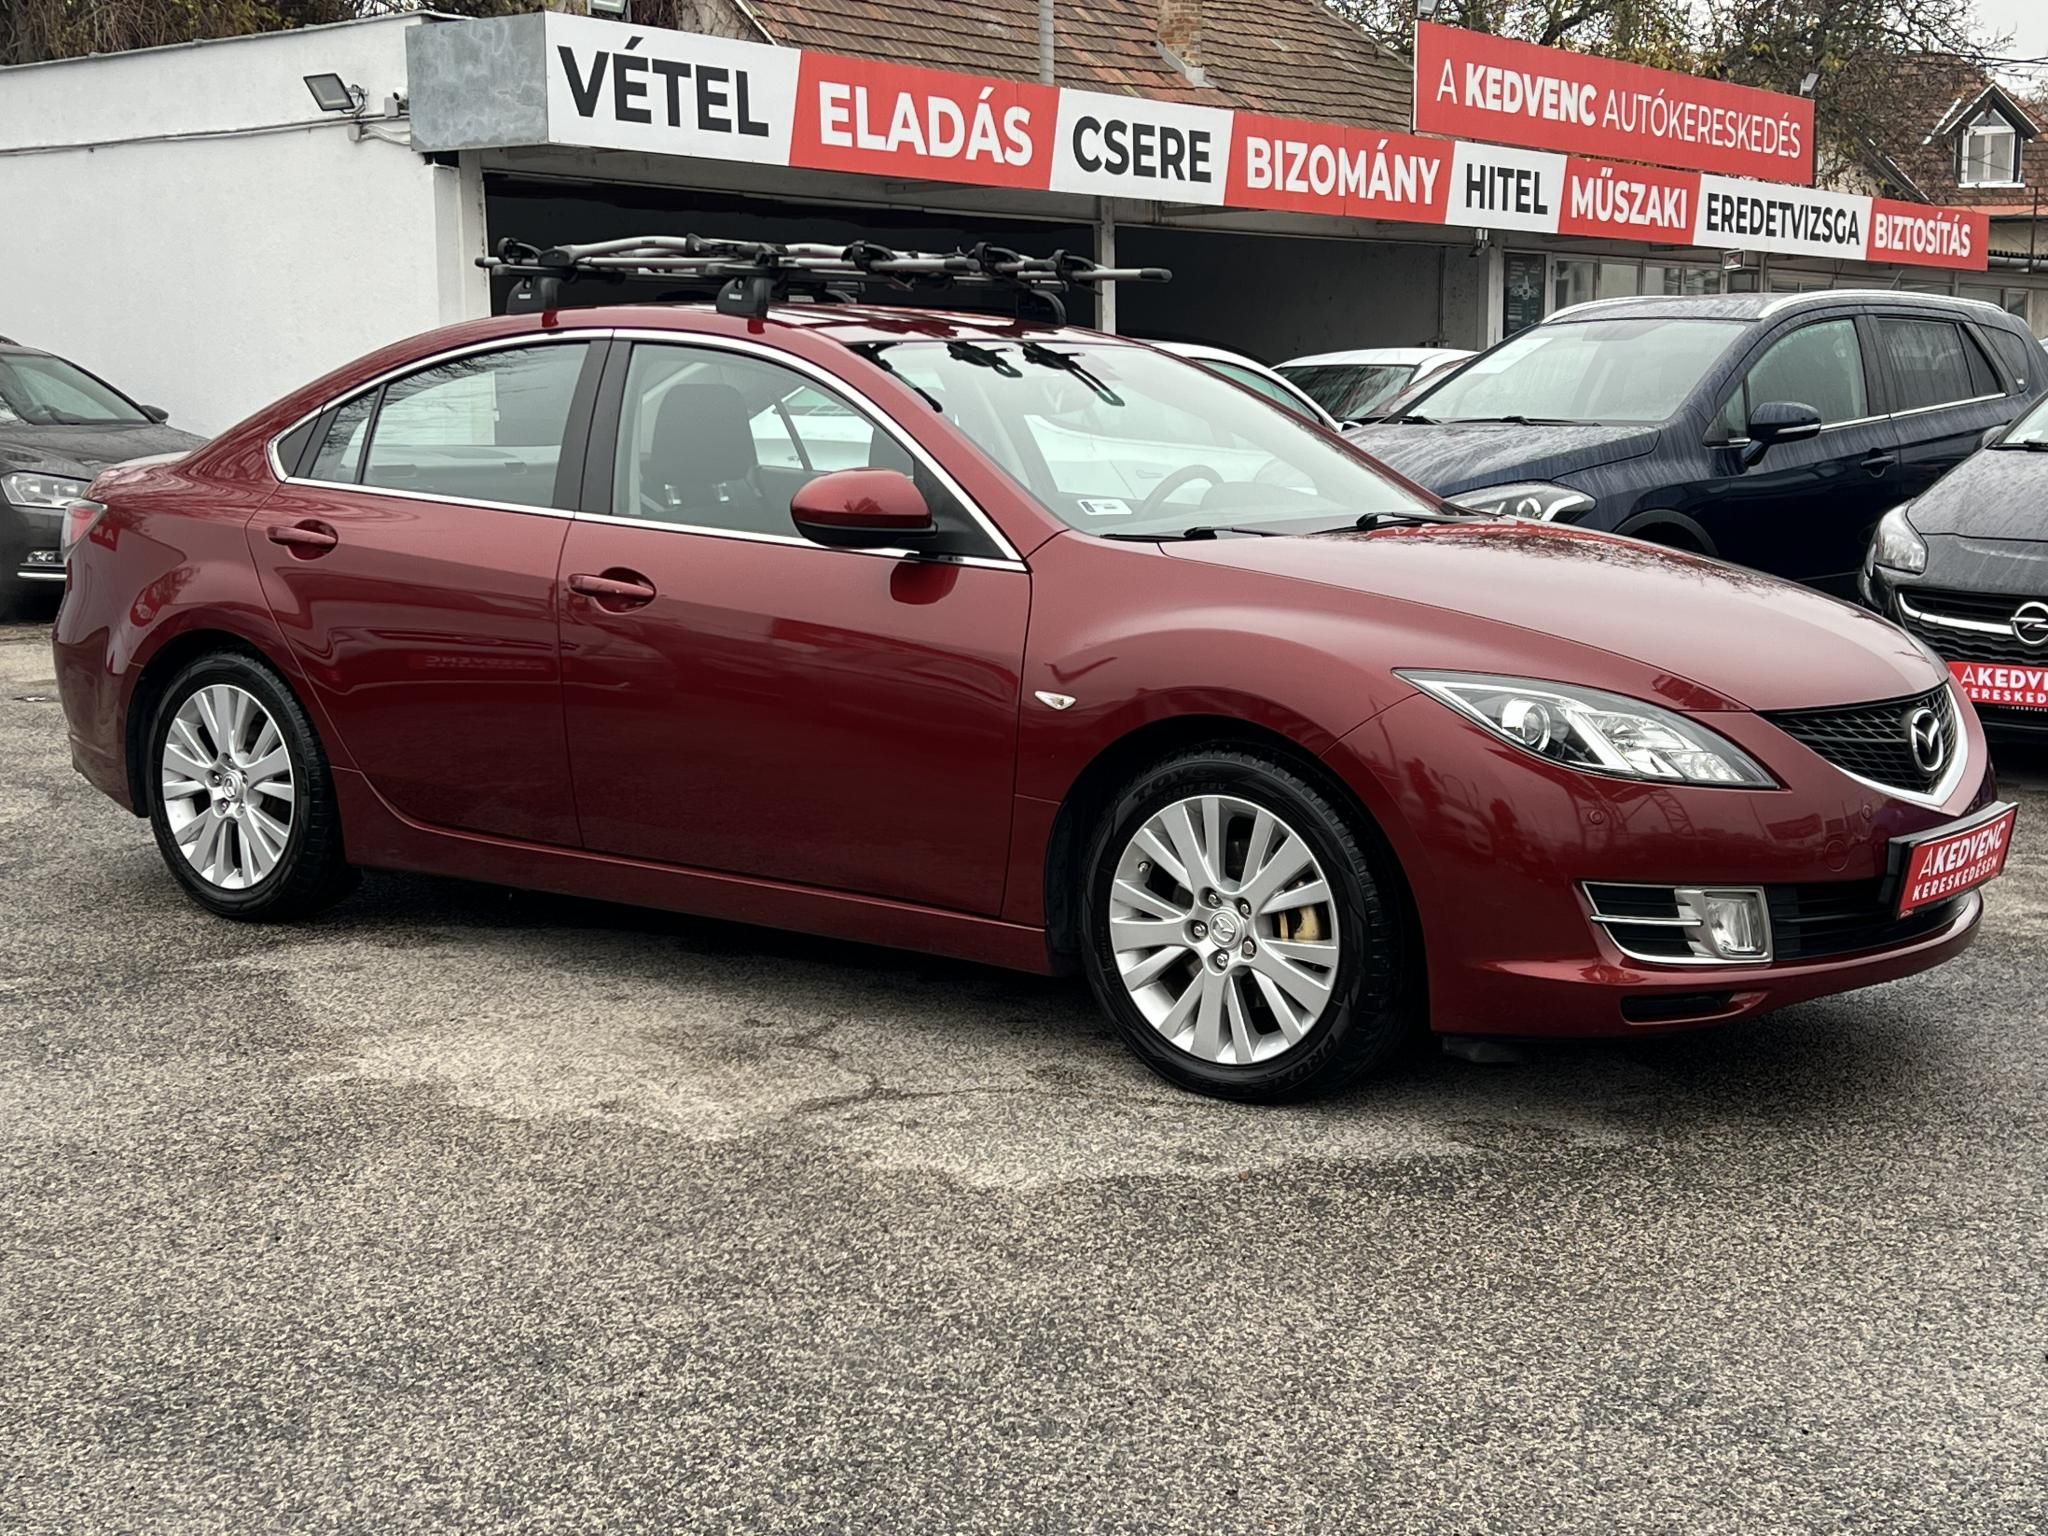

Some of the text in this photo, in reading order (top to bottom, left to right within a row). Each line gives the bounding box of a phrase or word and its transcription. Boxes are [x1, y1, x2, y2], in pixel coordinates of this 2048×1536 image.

[557, 36, 1971, 258] VÉTEL ELADÁS CSERE BIZOMÁNY HITEL MŰSZAKI EREDETVIZSGA BIZTOSÍTÁS
[1436, 58, 1801, 159] A KEDVENC AUTÓKERESKEDÉS
